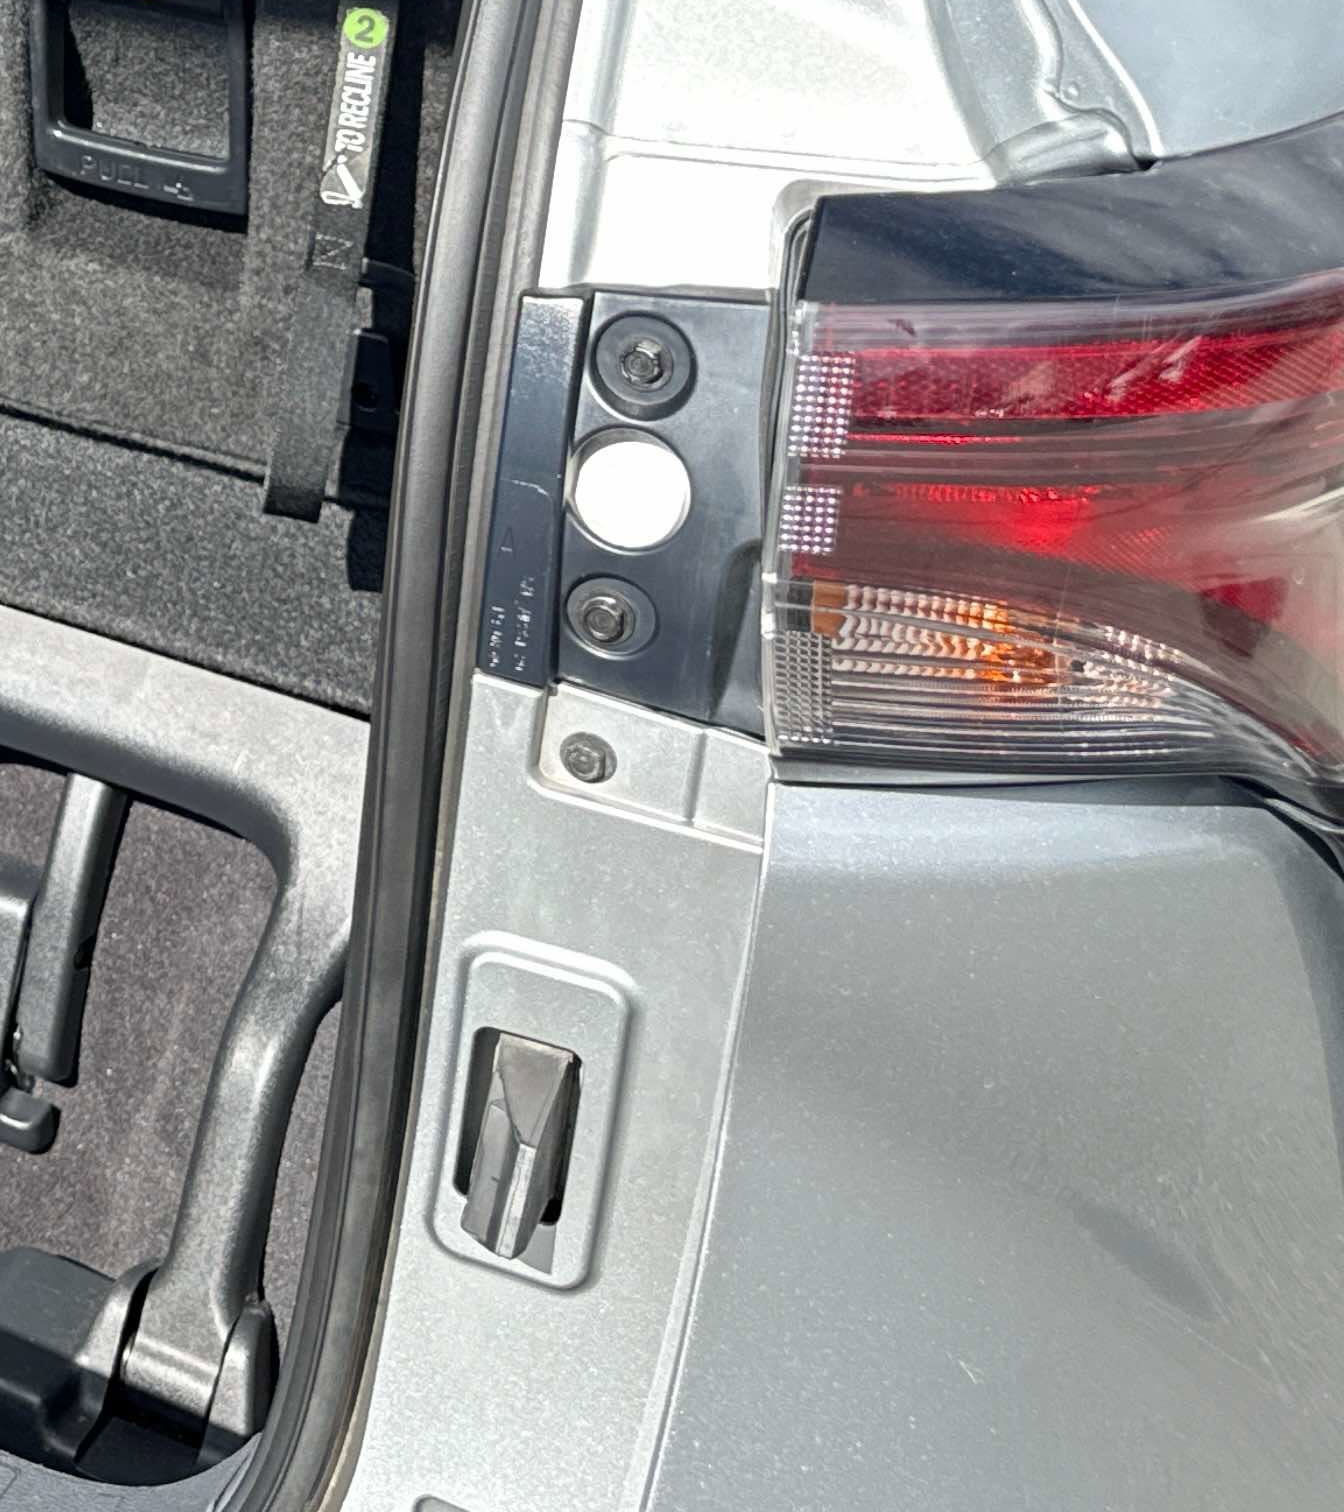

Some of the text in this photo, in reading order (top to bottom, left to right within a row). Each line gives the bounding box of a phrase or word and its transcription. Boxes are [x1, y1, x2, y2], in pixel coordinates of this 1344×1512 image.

[354, 15, 376, 43] 2
[335, 52, 377, 152] TO RECLINE
[78, 155, 150, 189] PULL
